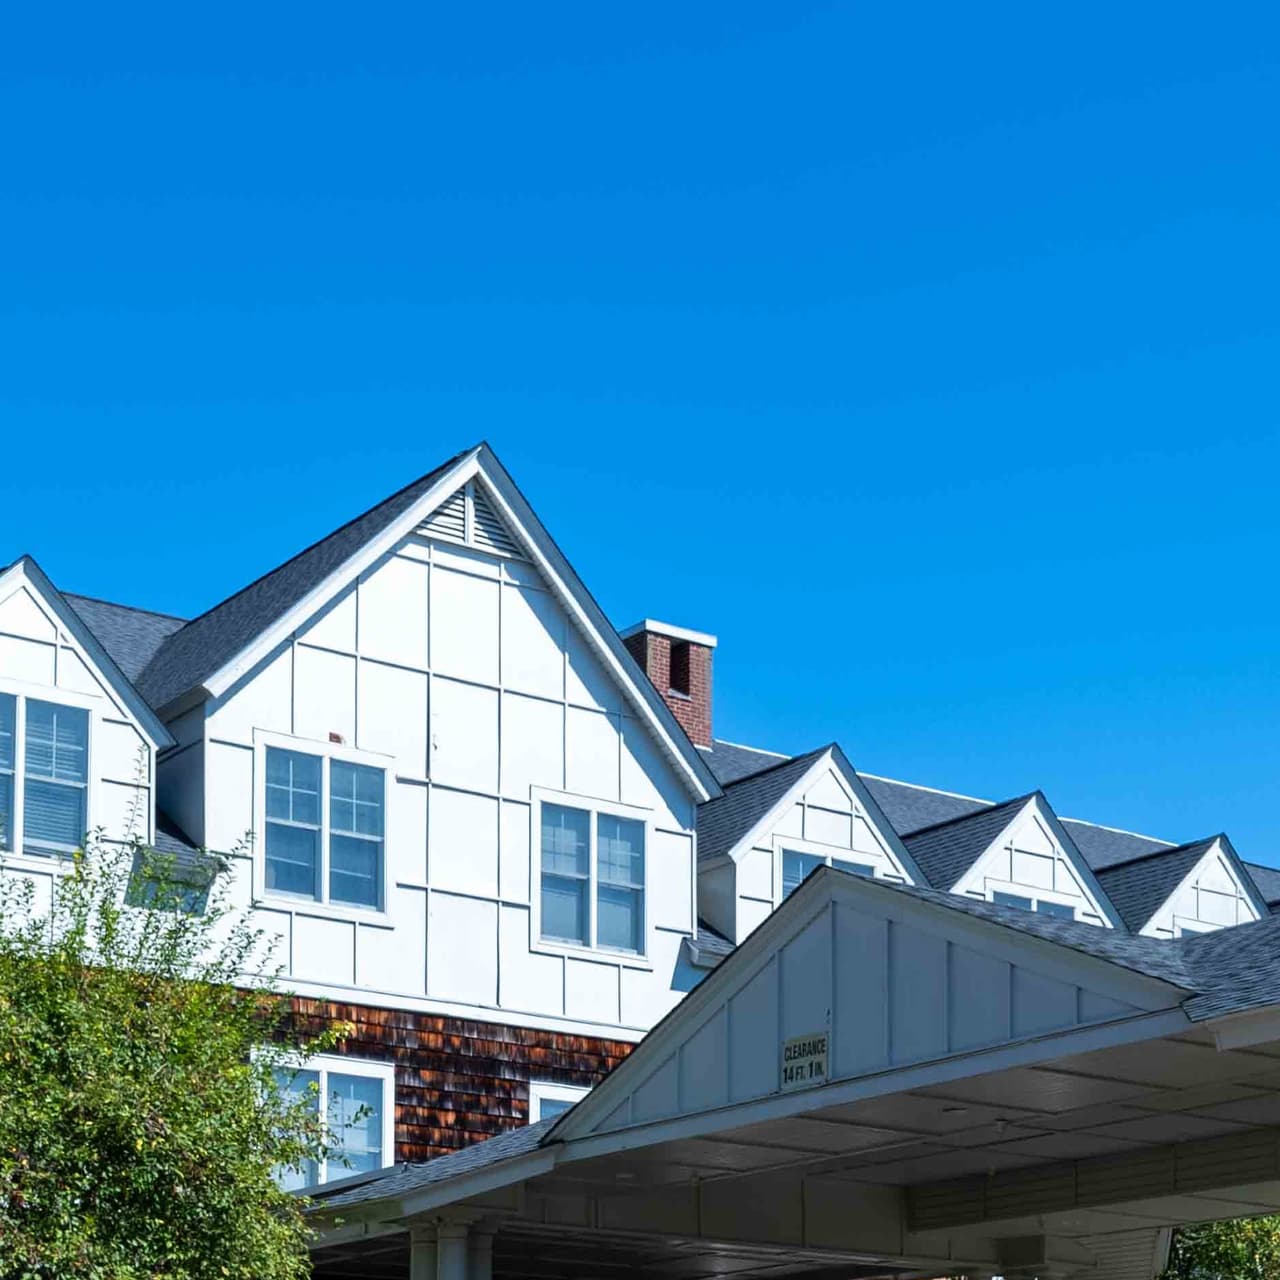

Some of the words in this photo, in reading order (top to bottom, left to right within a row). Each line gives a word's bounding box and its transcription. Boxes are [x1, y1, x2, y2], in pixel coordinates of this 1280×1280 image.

[784, 1038, 826, 1062] CLEARANCE
[783, 1065, 794, 1084] 14
[808, 1061, 814, 1079] 1
